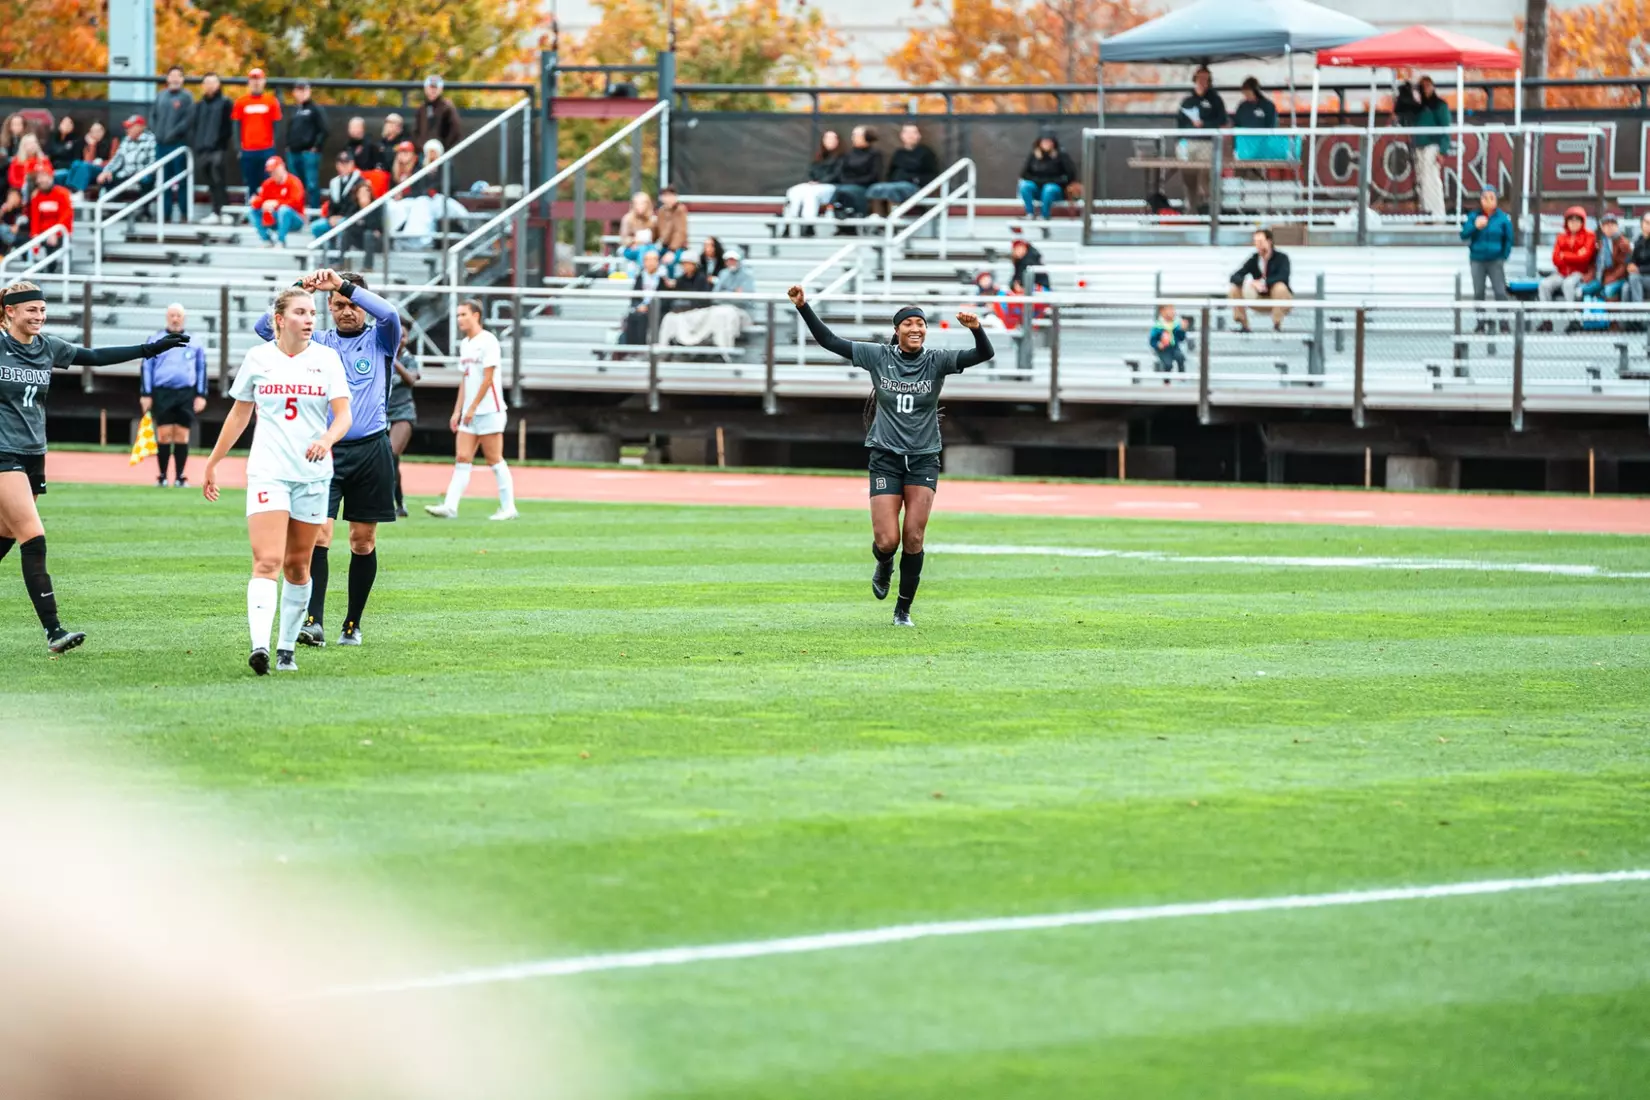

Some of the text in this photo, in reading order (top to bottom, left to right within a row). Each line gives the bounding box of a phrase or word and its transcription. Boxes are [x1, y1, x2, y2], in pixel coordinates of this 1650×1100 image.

[1314, 121, 1650, 198] CORNEL
[0, 365, 51, 385] BROW
[880, 376, 932, 393] BROWN
[23, 385, 38, 408] 11
[258, 384, 326, 396] CORNELL
[284, 396, 298, 421] 5
[896, 393, 914, 414] 10
[876, 477, 887, 490] B
[257, 491, 269, 504] C
